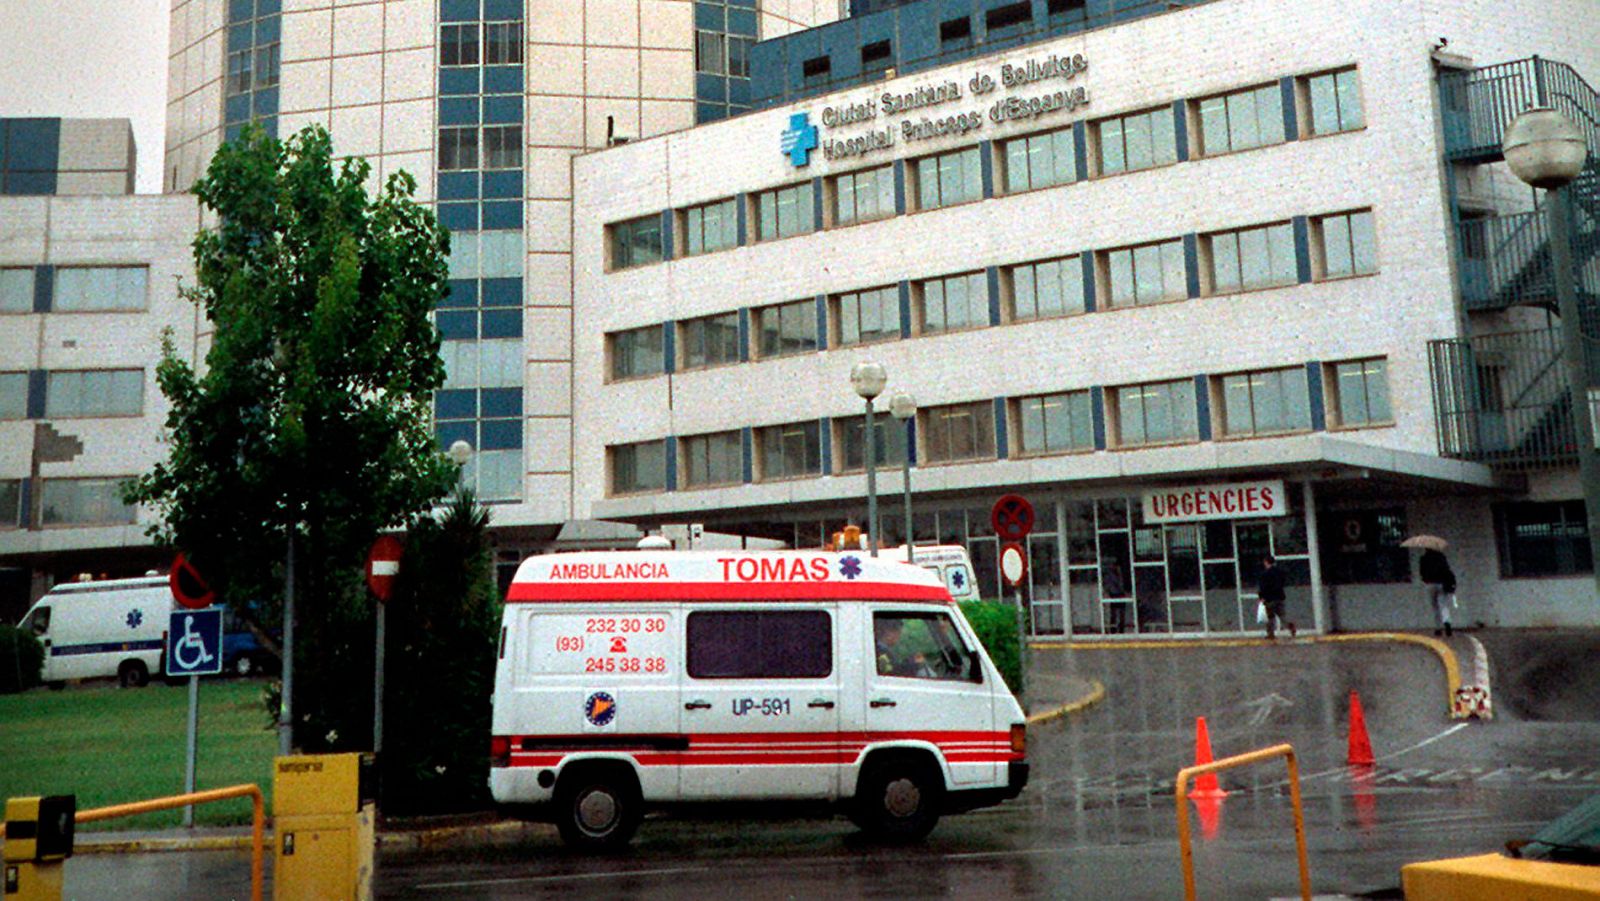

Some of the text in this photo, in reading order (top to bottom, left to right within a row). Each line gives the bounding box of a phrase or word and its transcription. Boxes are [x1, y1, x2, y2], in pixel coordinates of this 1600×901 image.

[822, 98, 877, 128] Ciutat
[969, 72, 996, 94] de
[1001, 53, 1088, 88] Bellvitge
[822, 126, 895, 160] Hospital
[550, 557, 830, 582] AMBULANCIA TOMAS
[586, 618, 666, 633] 232 30 30
[556, 635, 585, 653] (93)
[585, 657, 666, 673] 245 38 38
[731, 697, 791, 716] UP-591
